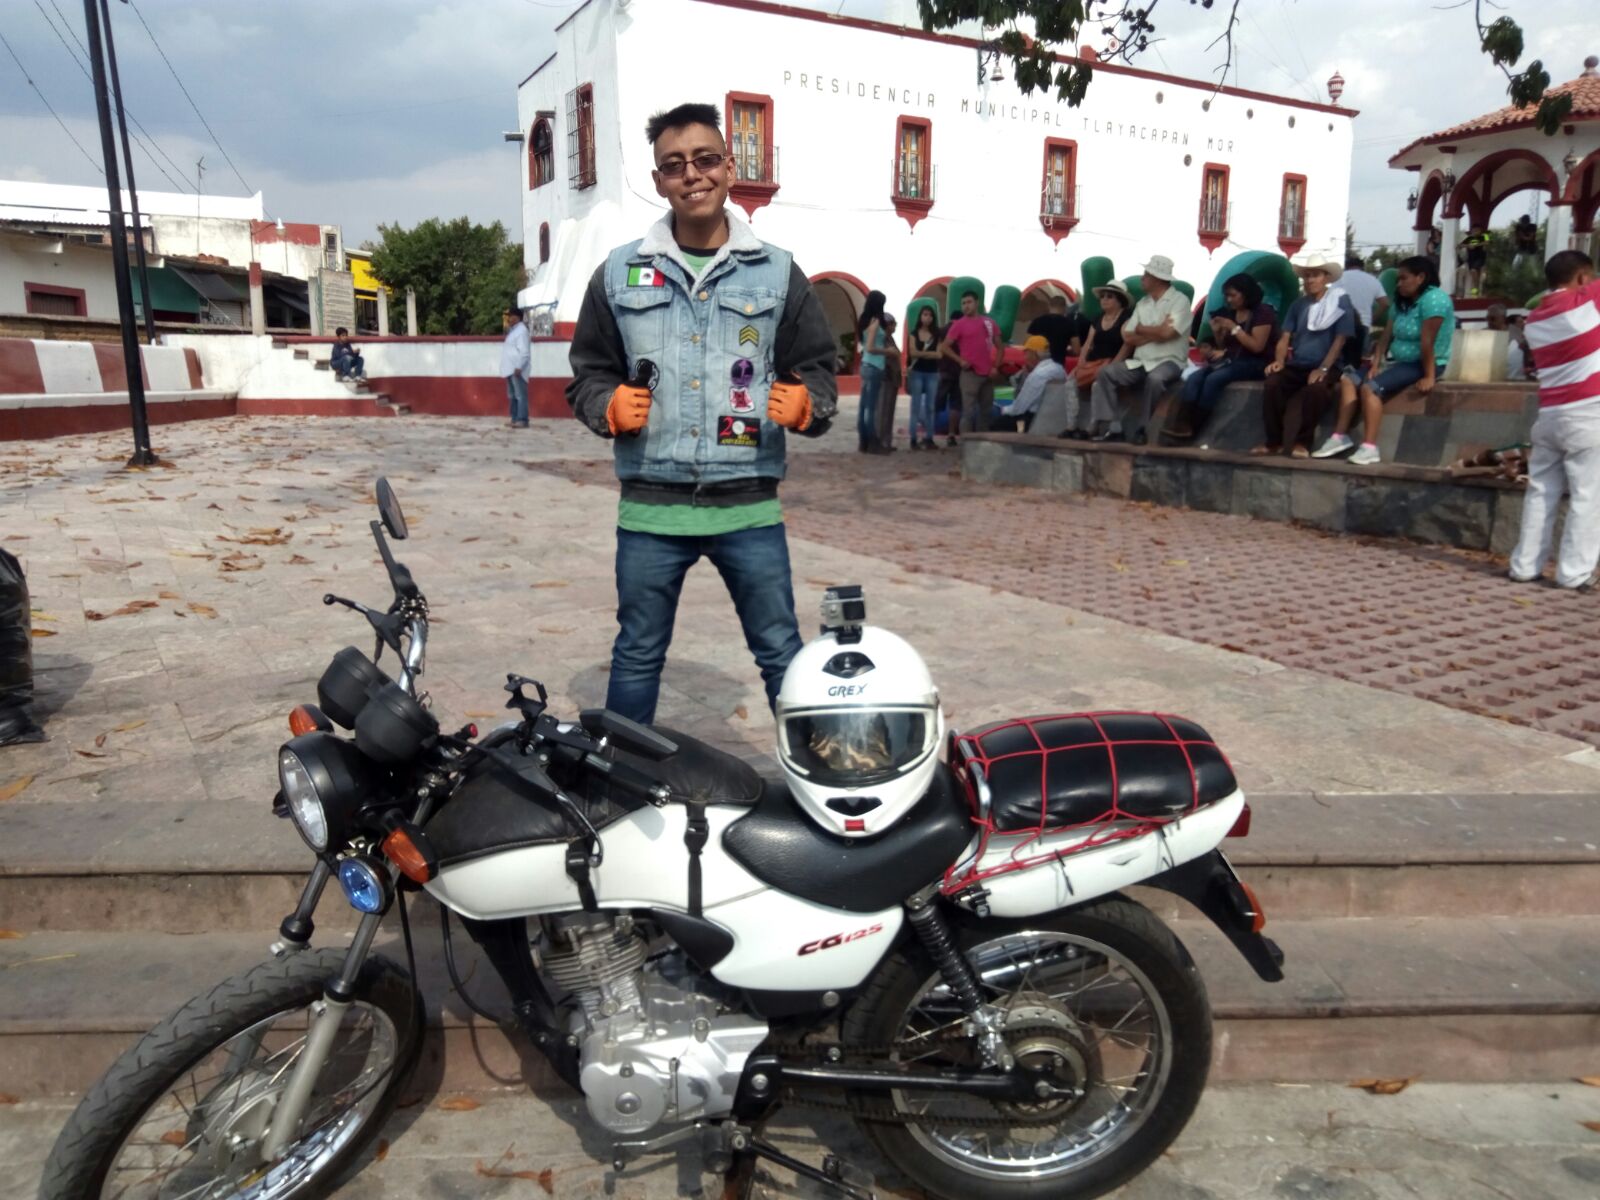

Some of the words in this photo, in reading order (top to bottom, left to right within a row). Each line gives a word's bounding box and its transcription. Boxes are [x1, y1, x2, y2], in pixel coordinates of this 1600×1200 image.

[783, 70, 935, 109] PRESIDENCIA
[961, 98, 1062, 127] MUNICIPAL
[1083, 117, 1189, 146] TLAYACAPAN
[1207, 136, 1234, 153] MOR
[827, 682, 869, 698] GREX
